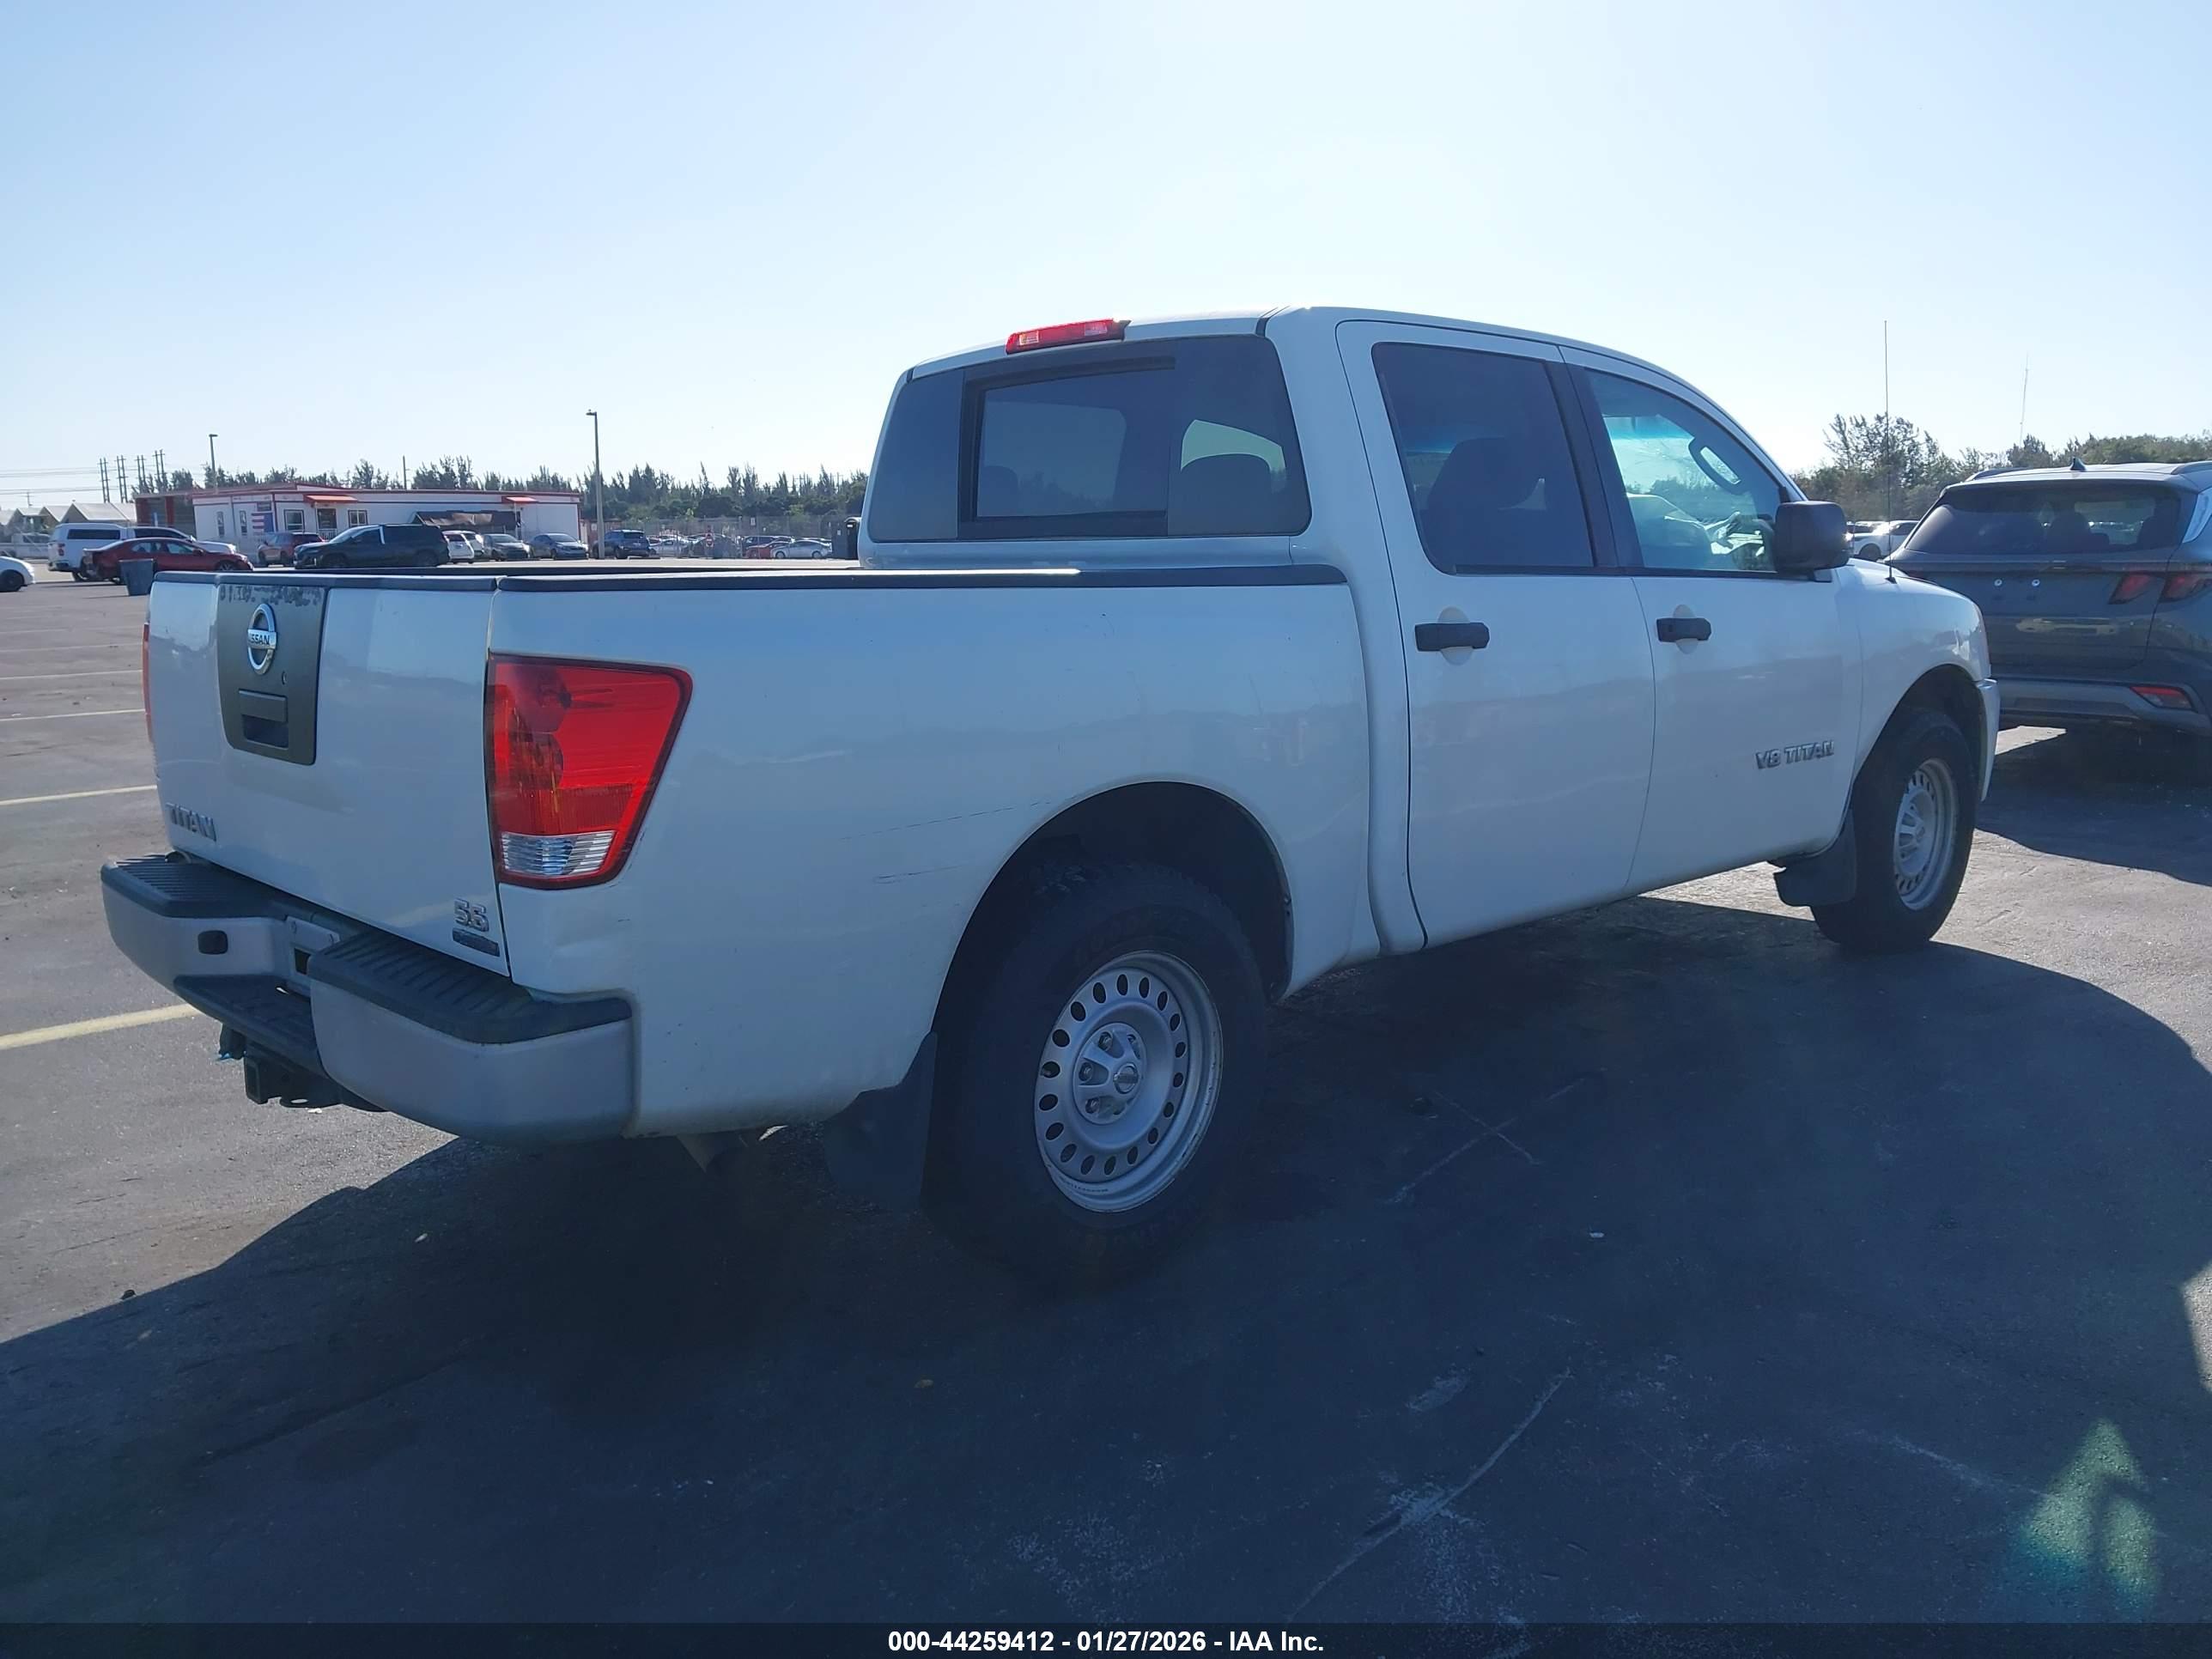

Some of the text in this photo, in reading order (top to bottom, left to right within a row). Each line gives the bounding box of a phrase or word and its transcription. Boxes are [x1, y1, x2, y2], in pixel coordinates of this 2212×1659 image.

[248, 633, 270, 646] SSAN
[1755, 740, 1834, 769] V8 TITAN
[166, 802, 217, 842] TITAN
